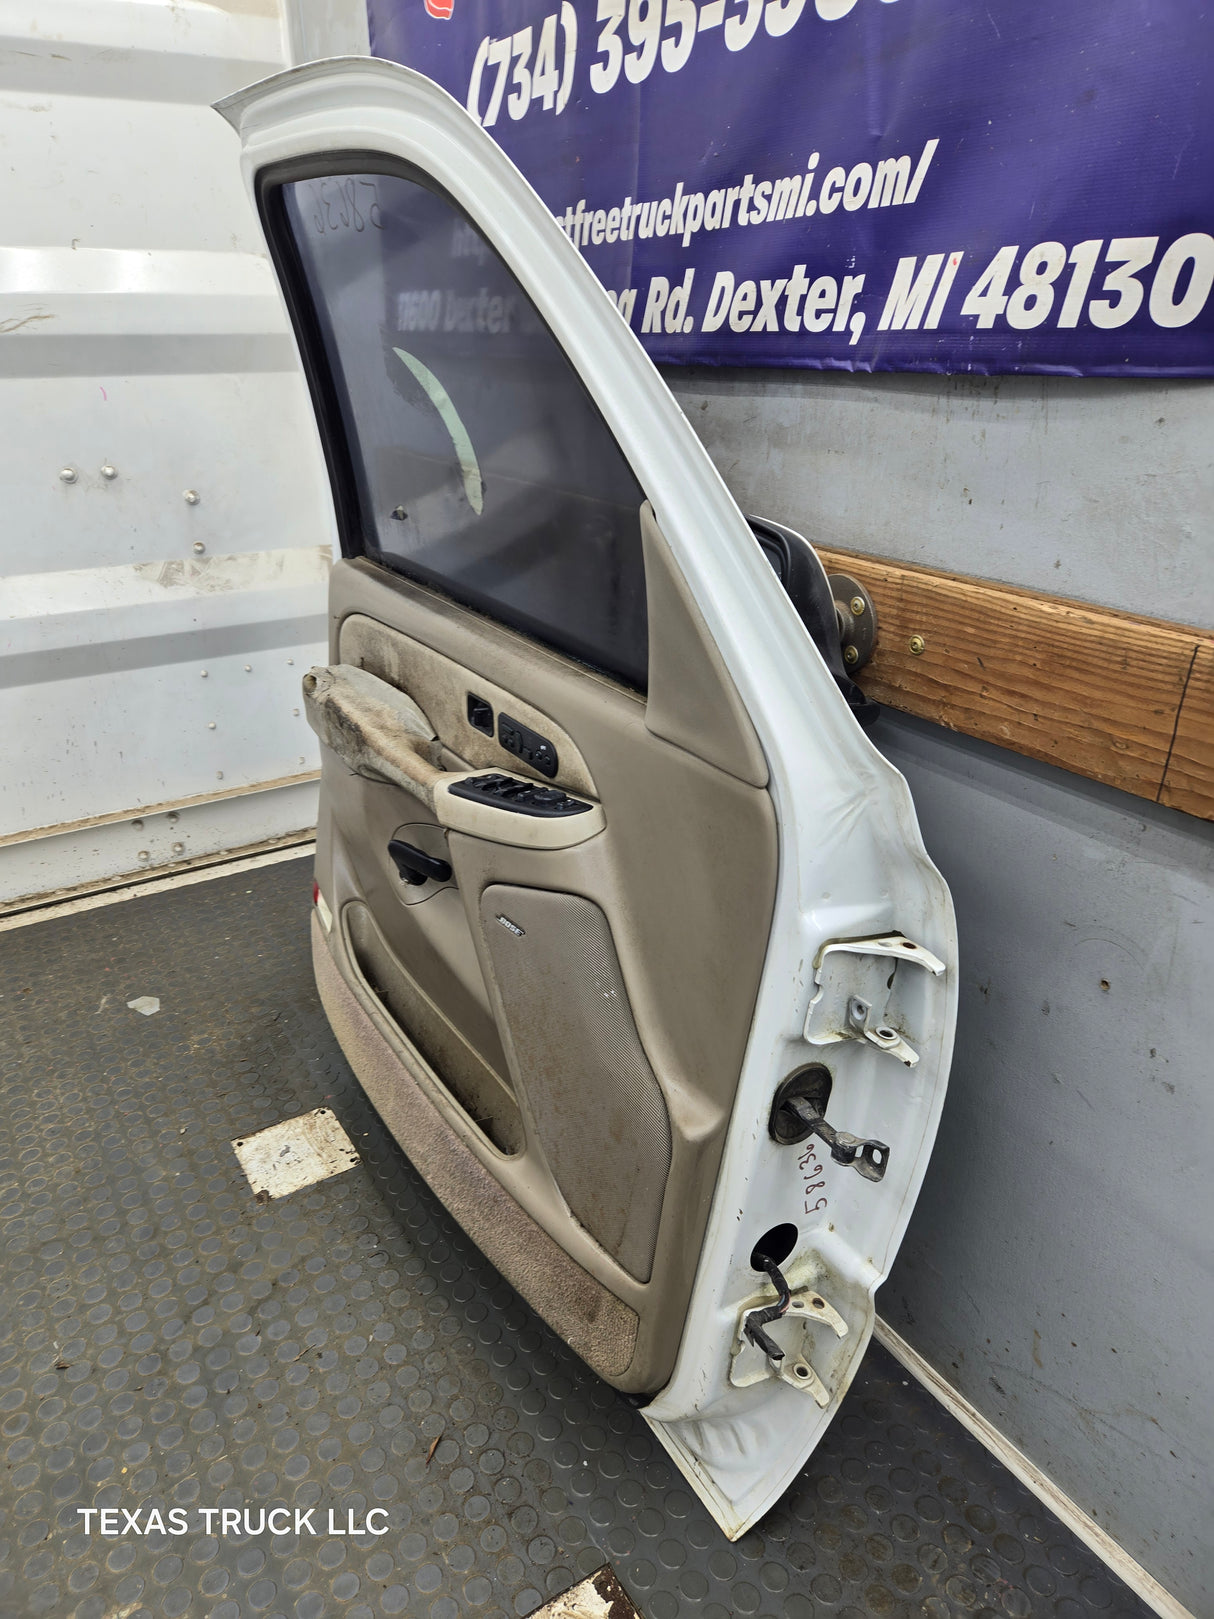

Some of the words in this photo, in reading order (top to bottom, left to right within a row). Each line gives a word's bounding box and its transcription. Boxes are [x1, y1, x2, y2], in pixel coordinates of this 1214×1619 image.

[467, 0, 578, 127] (734)
[641, 268, 695, 334] Rd.
[701, 264, 866, 346] Dexter,
[877, 251, 965, 331] MI
[960, 232, 1214, 330] 48130
[499, 916, 523, 936] BOSE
[798, 1143, 828, 1214] 58636
